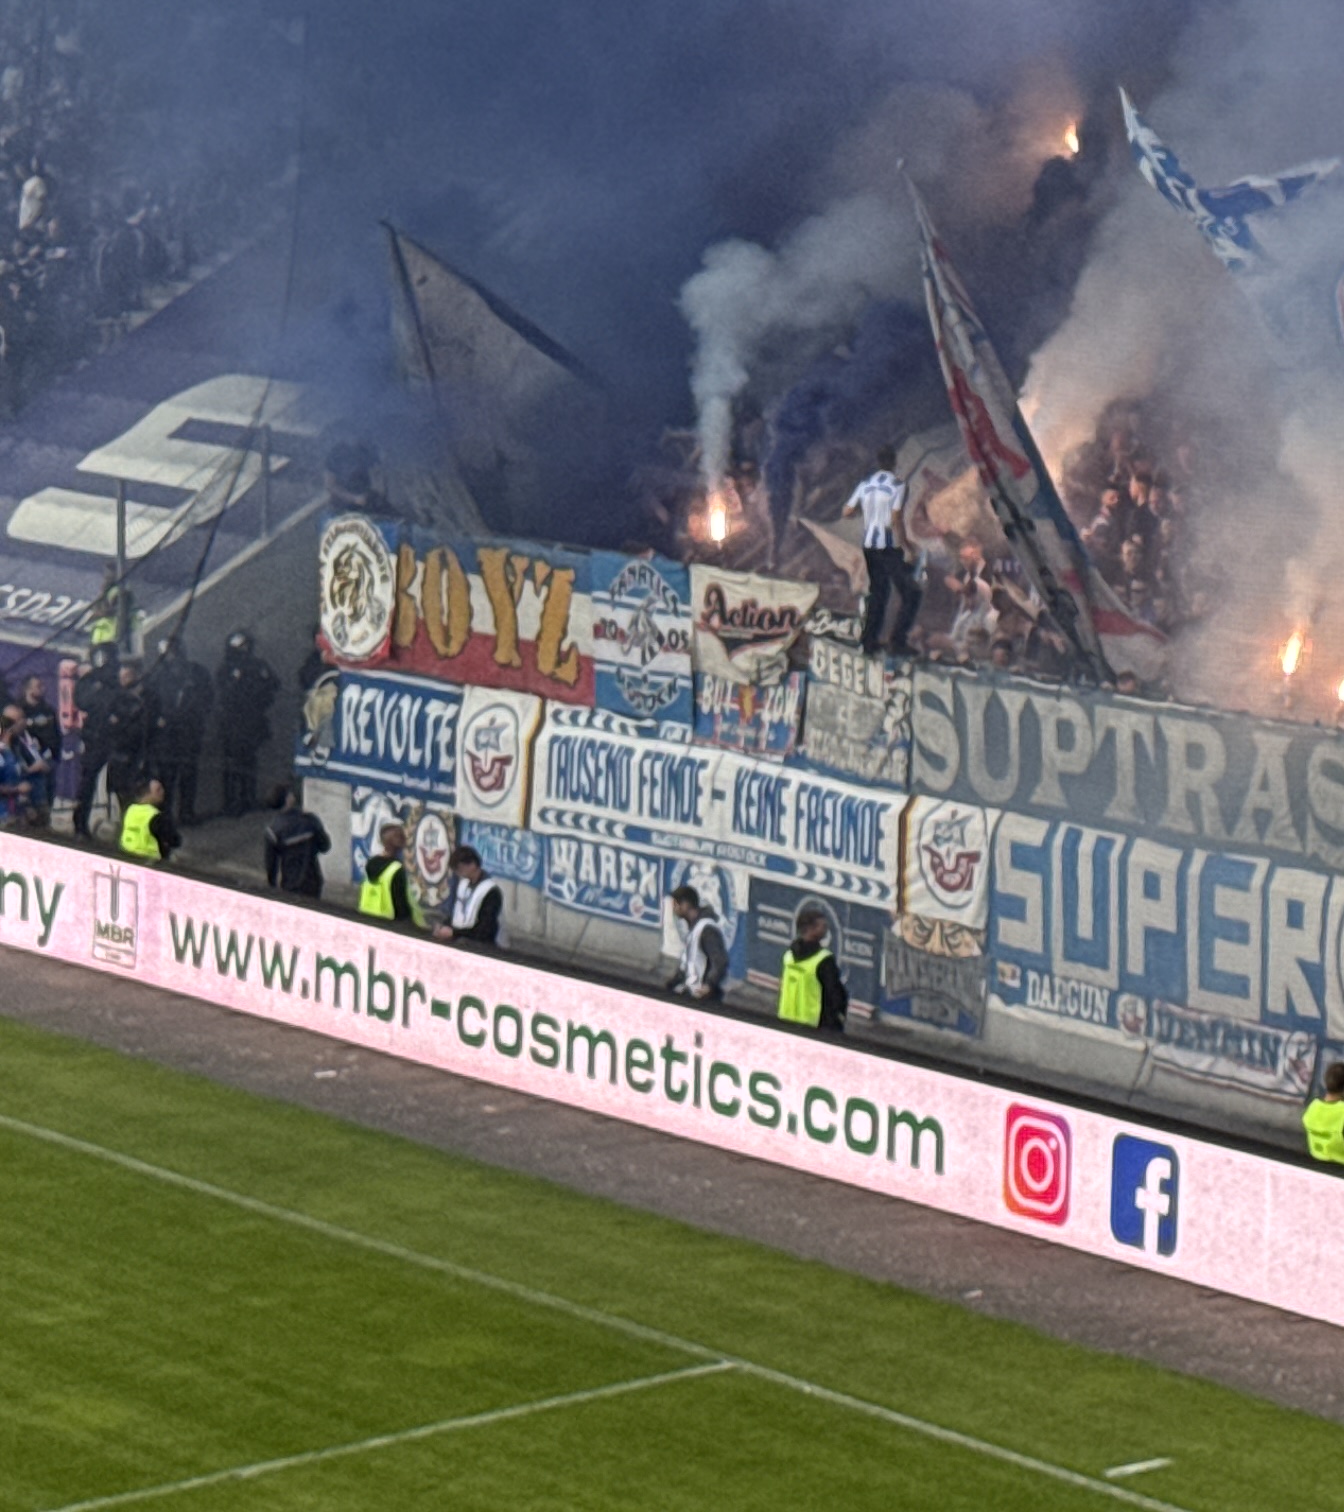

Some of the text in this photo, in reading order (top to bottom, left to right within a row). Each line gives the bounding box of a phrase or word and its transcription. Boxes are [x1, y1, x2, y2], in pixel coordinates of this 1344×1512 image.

[702, 582, 800, 631] Action
[341, 684, 461, 773] REVOLTE
[546, 734, 635, 814] TAUSEND
[637, 747, 711, 826] FEINDE
[731, 765, 793, 847] KEINE
[795, 781, 893, 872] FREUNDE
[95, 918, 135, 948] MBR
[996, 810, 1330, 1021] SUPER
[169, 911, 946, 1177] www.mbr-cosmetics.com
